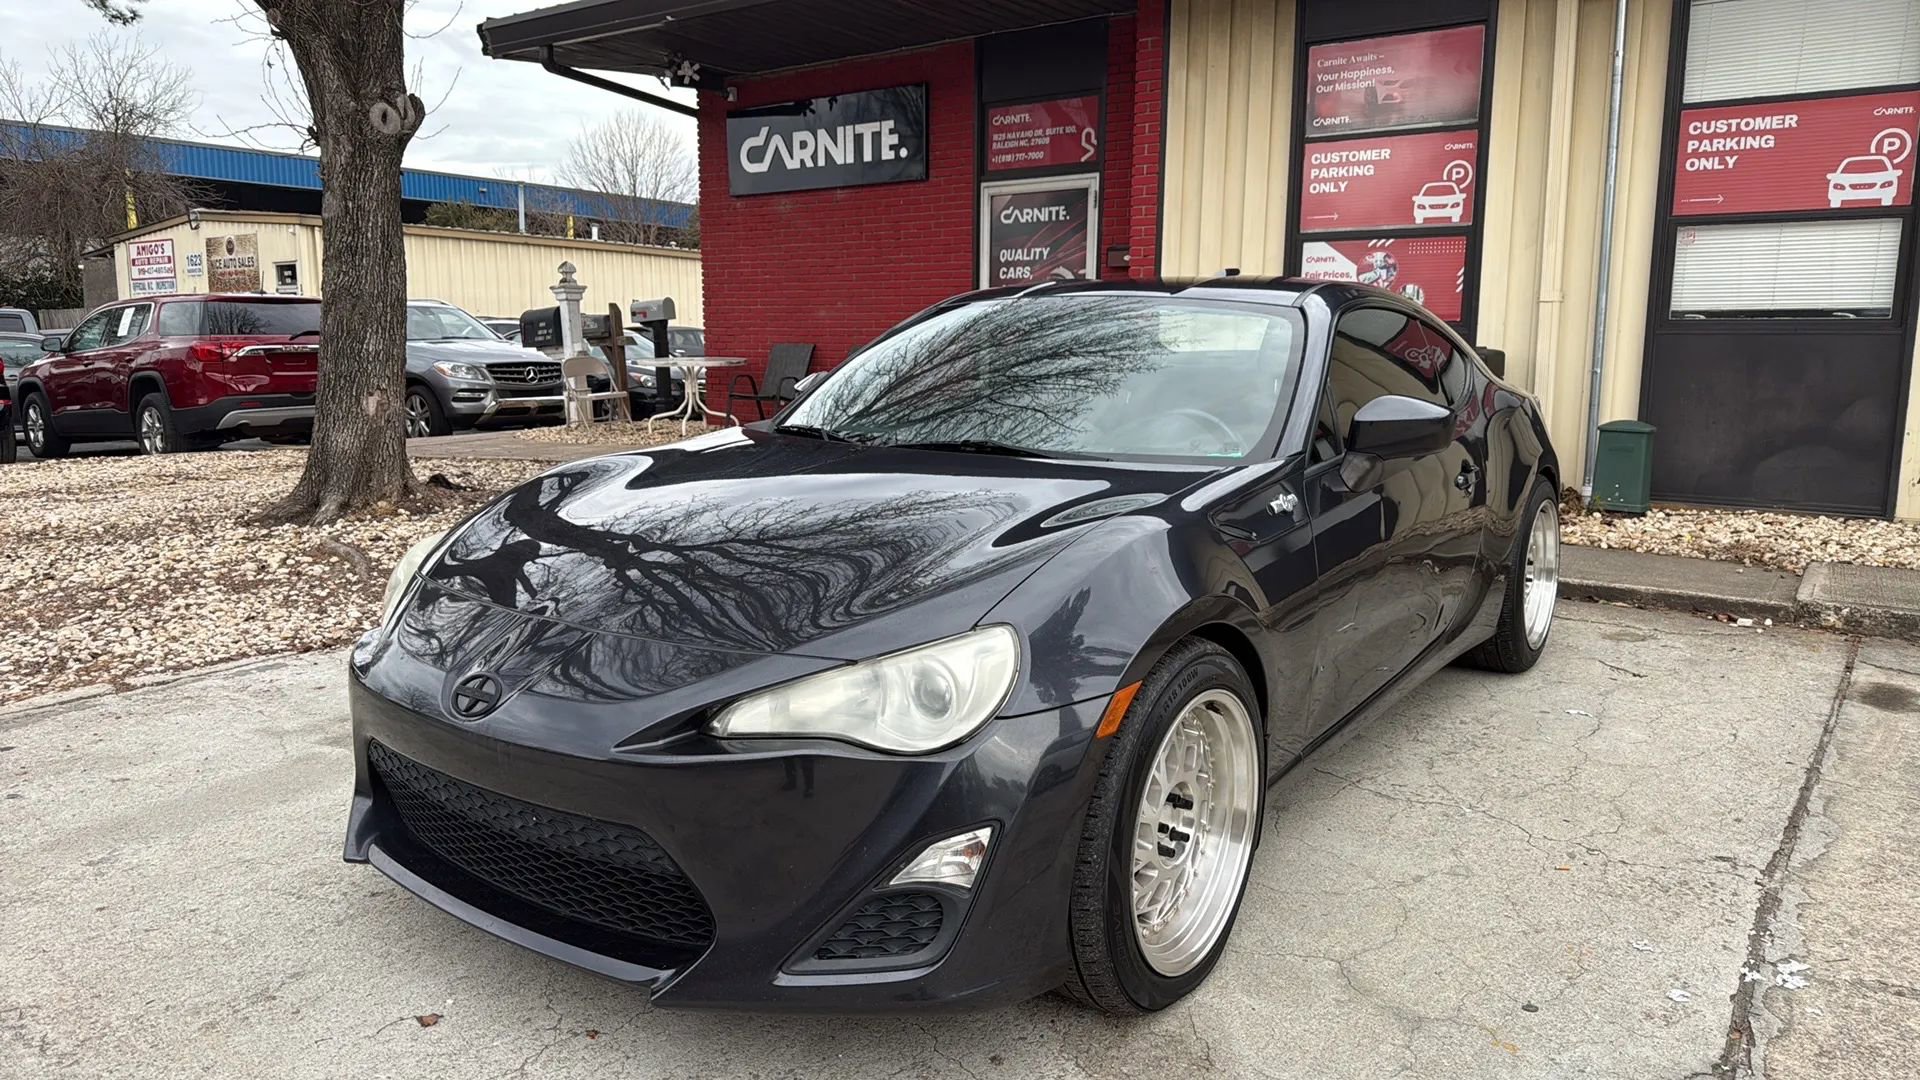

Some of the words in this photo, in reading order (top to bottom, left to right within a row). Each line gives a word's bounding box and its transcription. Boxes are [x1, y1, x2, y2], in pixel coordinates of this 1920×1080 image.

[1317, 56, 1347, 69] Carnite
[1348, 53, 1378, 65] Awaits
[1316, 70, 1340, 82] Your
[1340, 65, 1395, 81] Happiness,
[1316, 83, 1334, 94] Our
[1335, 78, 1376, 92] Mission!
[992, 113, 1032, 126] CARNITE.
[1688, 113, 1799, 136] CUSTOMER
[740, 119, 908, 174] CARNITE.
[1686, 135, 1776, 154] PARKING
[1311, 148, 1391, 165] CUSTOMER
[1685, 155, 1739, 172] ONLY
[1310, 164, 1375, 180] PARKING
[1309, 180, 1349, 194] ONLY
[1000, 205, 1070, 225] CARNITE.
[136, 242, 166, 257] AMIGO'S
[1000, 247, 1050, 263] QUALITY
[134, 258, 149, 267] AUTO
[149, 256, 169, 266] REPAIR
[186, 254, 202, 267] 1623
[223, 256, 237, 269] AUTO
[237, 255, 255, 269] SALES
[999, 265, 1034, 281] CARS,
[1304, 270, 1321, 281] Fair
[1322, 269, 1353, 281] Prices,
